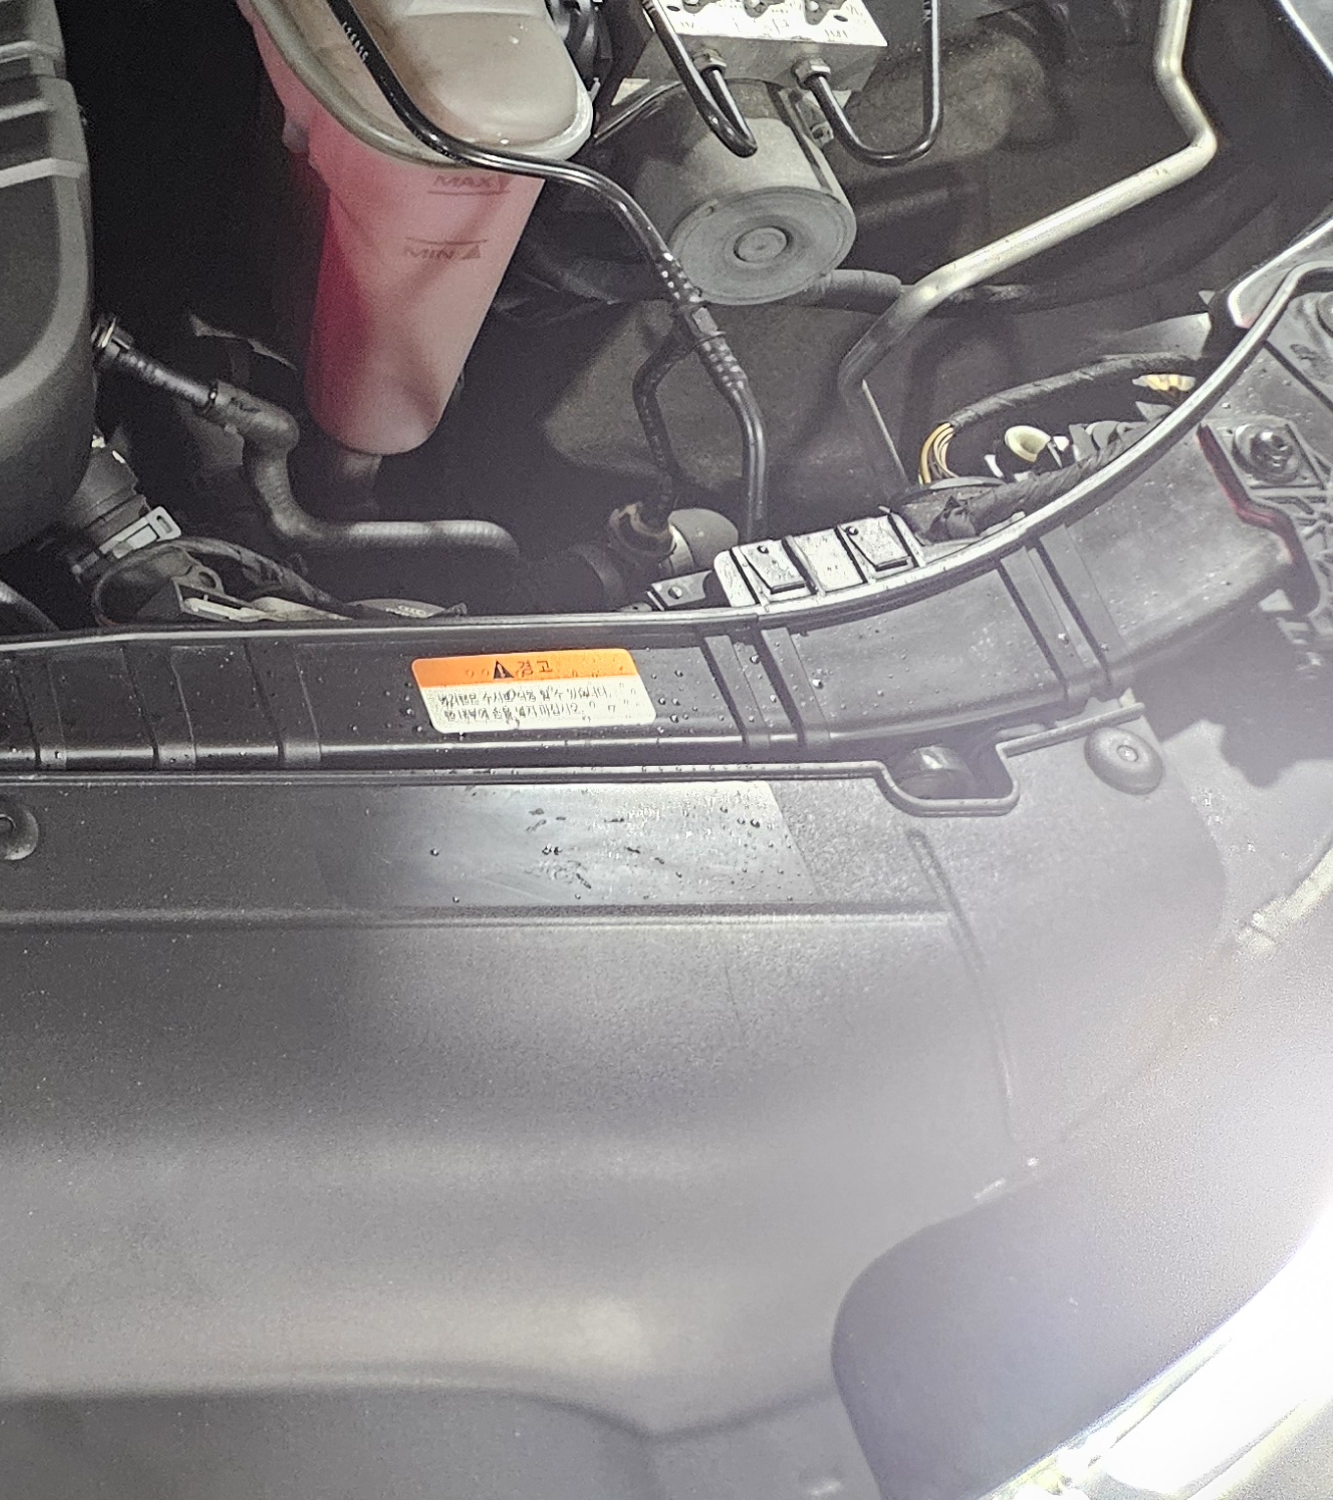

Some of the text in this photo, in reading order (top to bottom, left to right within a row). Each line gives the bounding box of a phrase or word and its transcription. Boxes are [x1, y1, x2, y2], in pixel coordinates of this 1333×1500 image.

[433, 174, 493, 188] MAX
[404, 245, 455, 260] MIN
[517, 660, 553, 678] 경고
